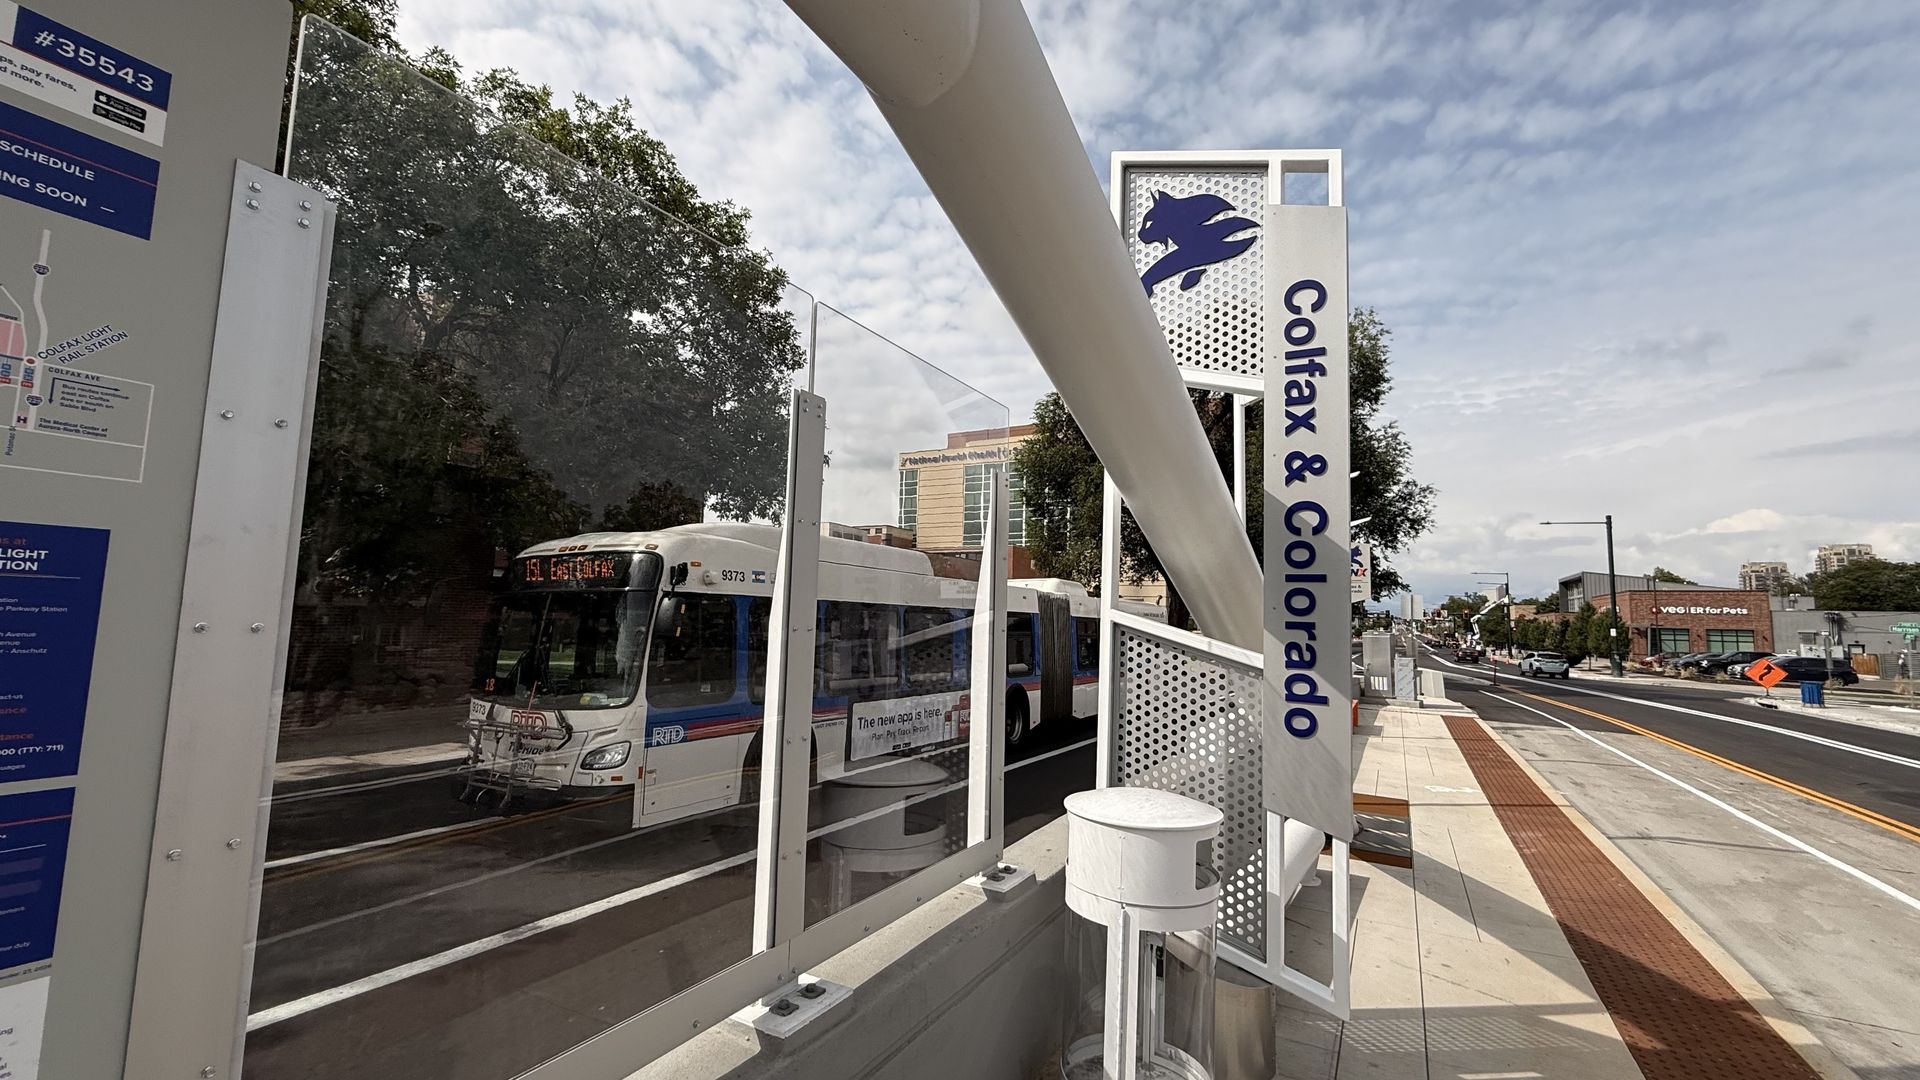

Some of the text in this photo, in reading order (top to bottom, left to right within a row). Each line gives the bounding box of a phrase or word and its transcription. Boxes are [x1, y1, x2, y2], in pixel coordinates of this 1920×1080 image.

[34, 30, 153, 92] #35543
[10, 70, 44, 88] more.
[20, 63, 43, 77] pay
[45, 73, 77, 92] fares,
[0, 140, 95, 181] SCHEDULE
[35, 182, 87, 207] SOON
[37, 324, 113, 360] COLFAX LIGHT
[58, 331, 129, 364] RAIL STATION
[48, 366, 101, 382] COLFAX AVE
[1284, 279, 1330, 739] Colfax & Colorado
[0, 548, 49, 559] LIGHT
[526, 559, 544, 581] 15L
[721, 569, 746, 582] 9373
[1690, 606, 1704, 614] ER
[1705, 606, 1722, 614] for
[1723, 606, 1749, 615] Pets
[857, 716, 875, 730] The
[877, 713, 895, 726] new
[897, 711, 913, 725] app
[914, 708, 922, 720] is
[652, 725, 685, 747] RTD
